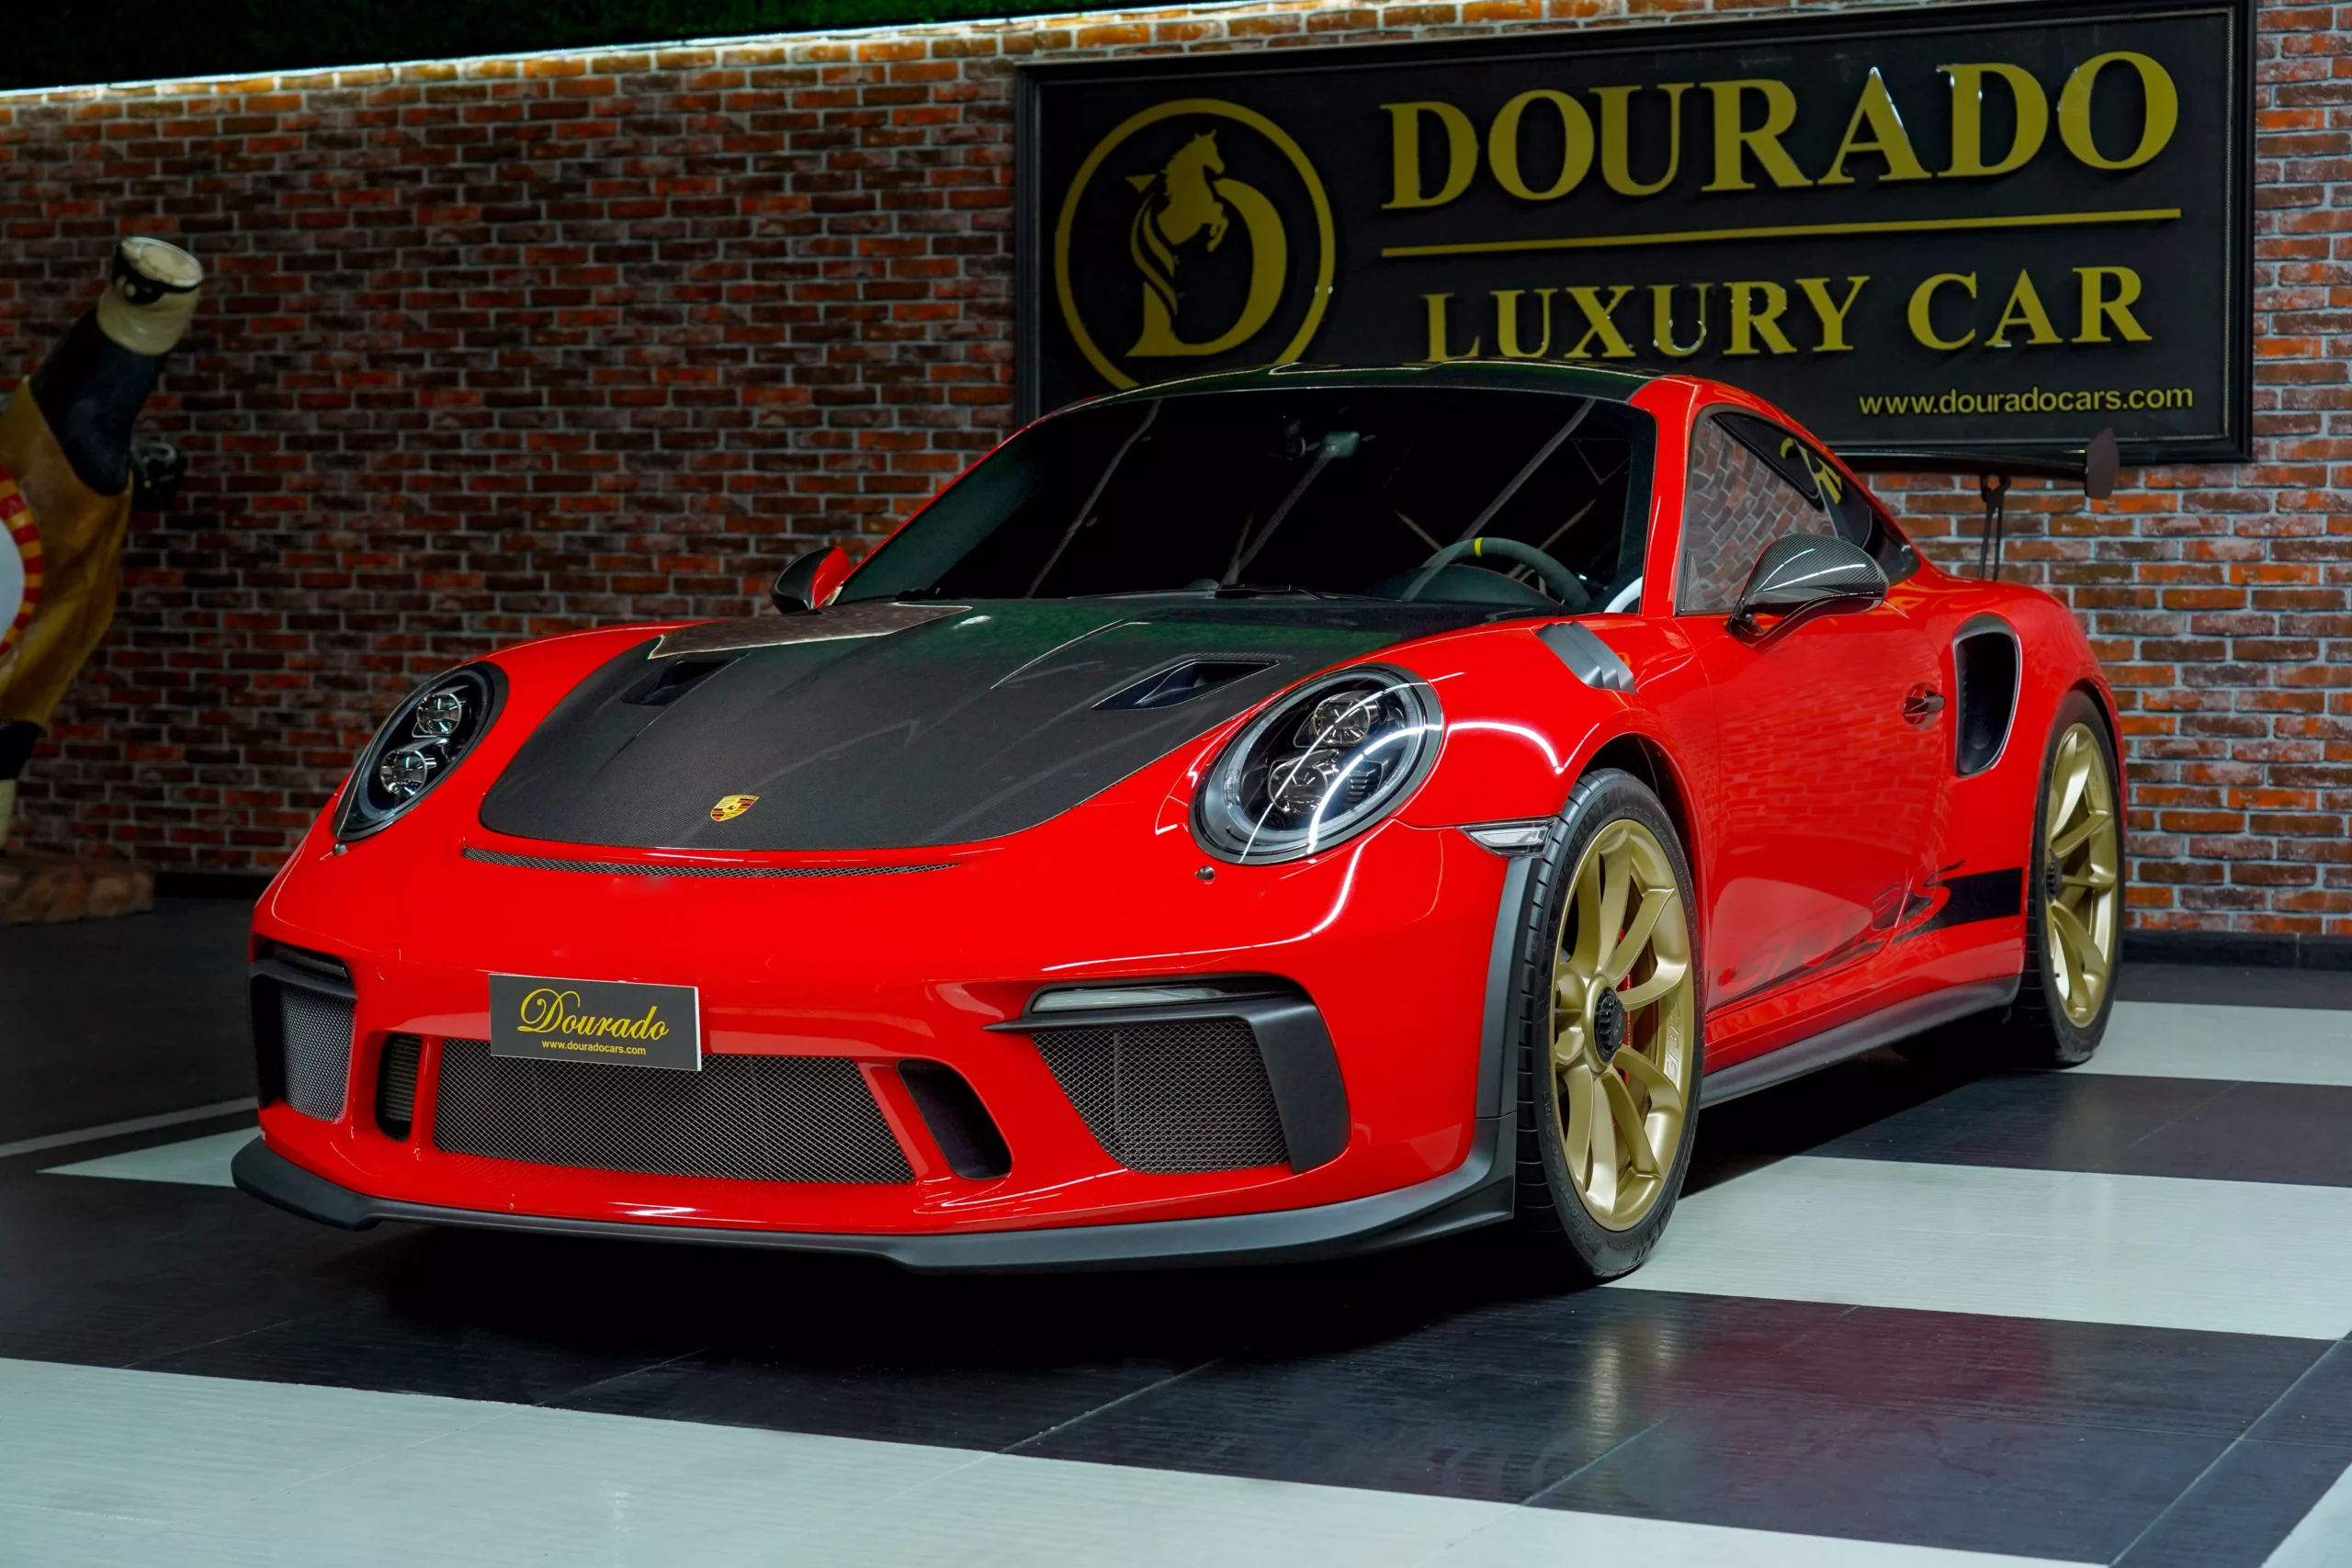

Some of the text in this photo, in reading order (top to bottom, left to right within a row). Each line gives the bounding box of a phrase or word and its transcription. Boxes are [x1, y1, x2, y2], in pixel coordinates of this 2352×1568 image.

[1380, 51, 2178, 209] DOURADO
[1421, 266, 2152, 362] LUXURY CAR
[1859, 388, 2194, 415] www.douradocars.com
[517, 988, 670, 1040] Dourado
[541, 1040, 647, 1055] www.douradocars.com
